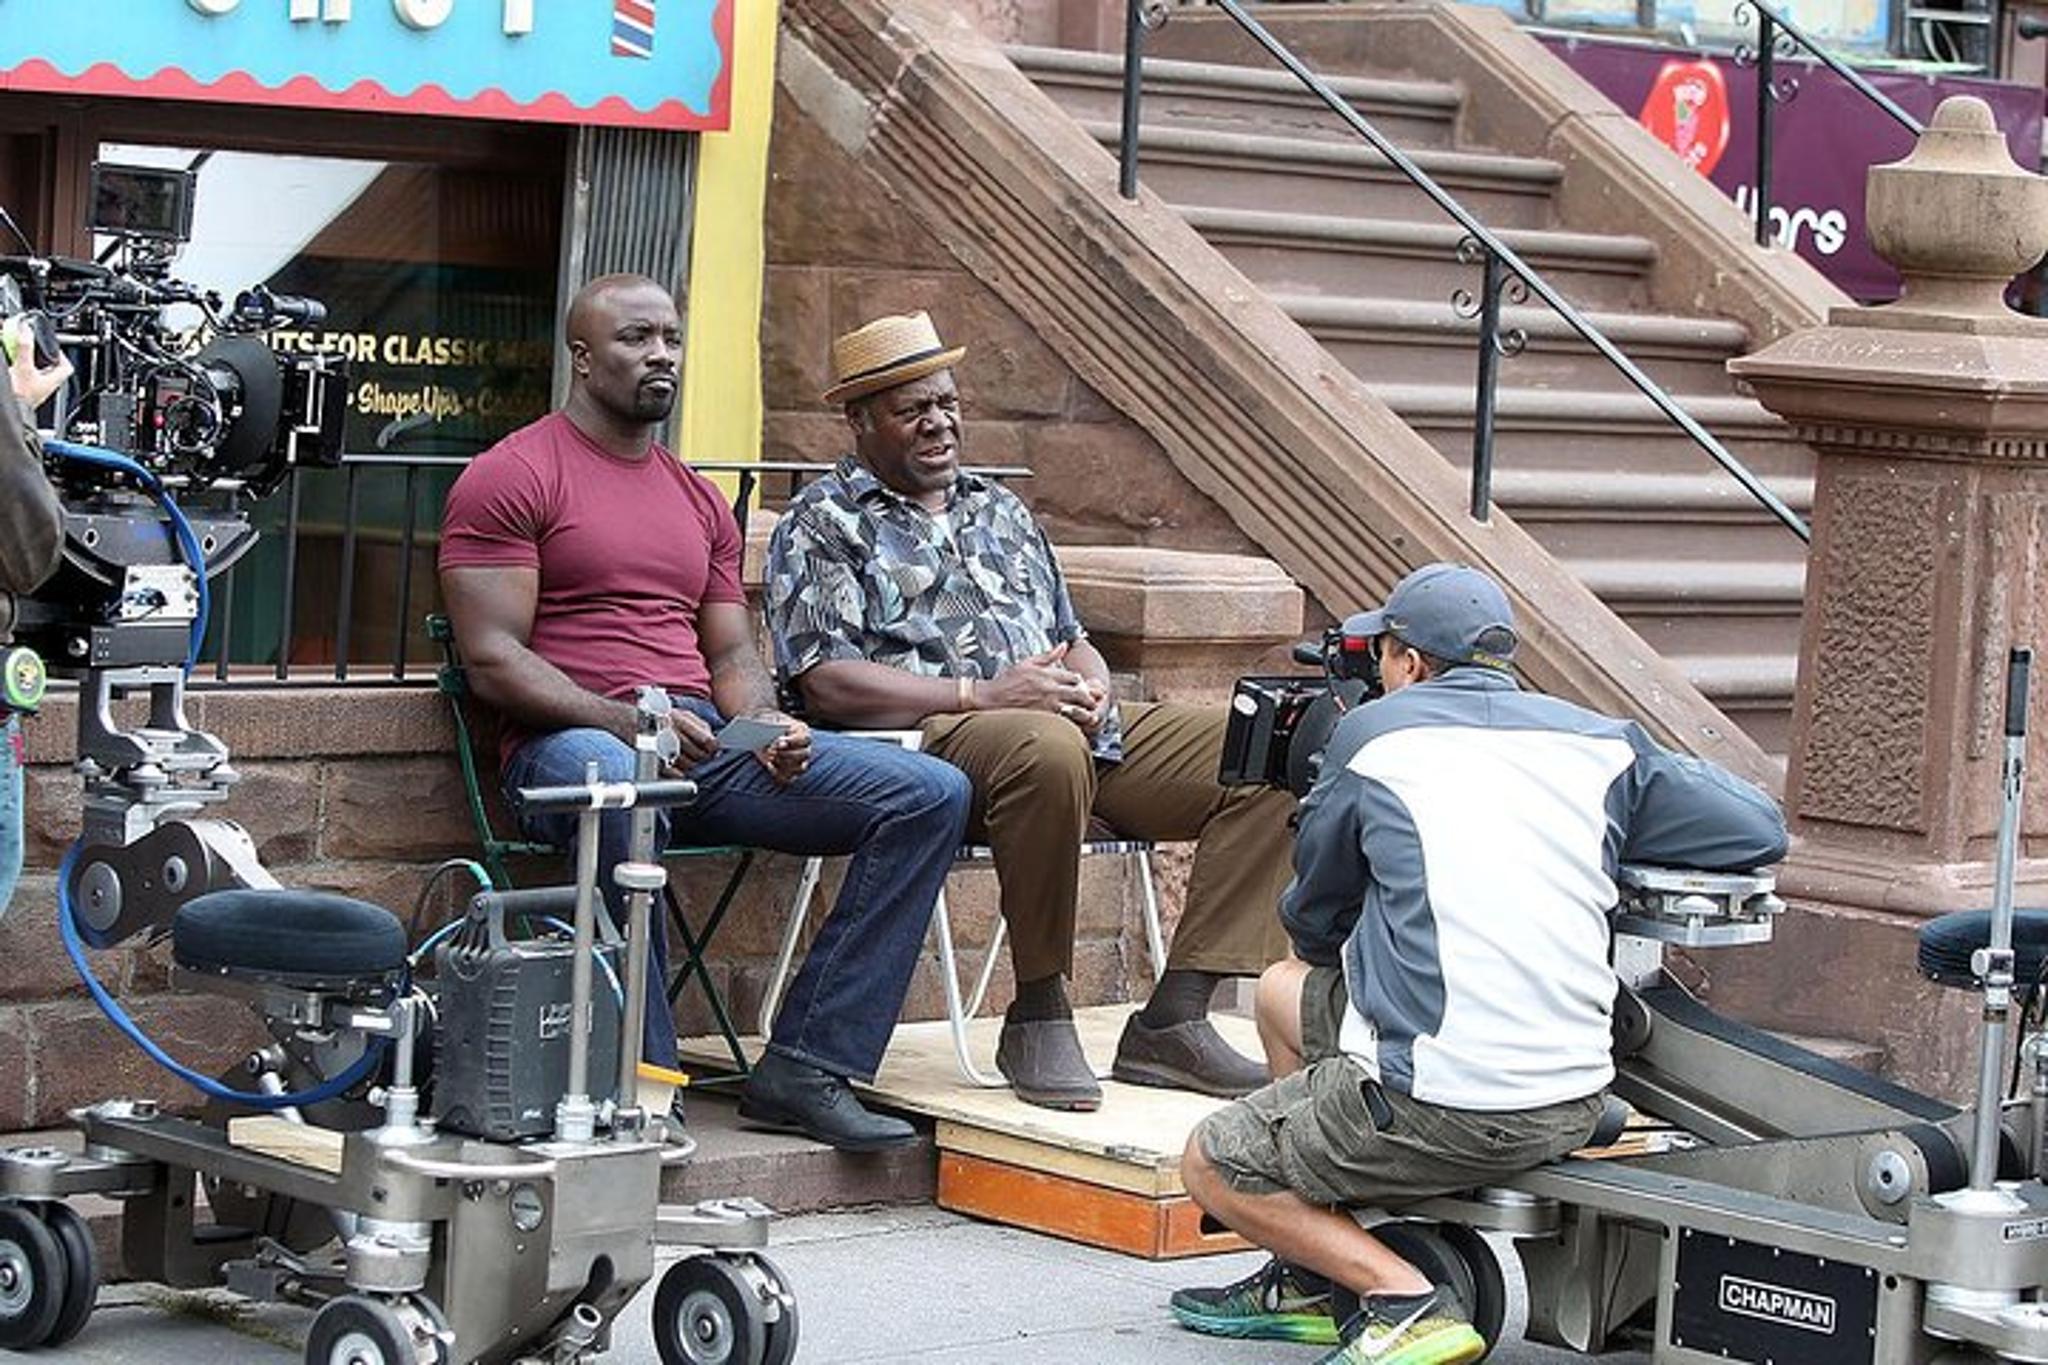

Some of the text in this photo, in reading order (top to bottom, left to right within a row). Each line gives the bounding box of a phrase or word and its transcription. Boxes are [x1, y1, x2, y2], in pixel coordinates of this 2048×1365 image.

[321, 332, 377, 362] FOR
[383, 333, 492, 366] CLASSIC
[1726, 1284, 1830, 1325] CHAPMAN
